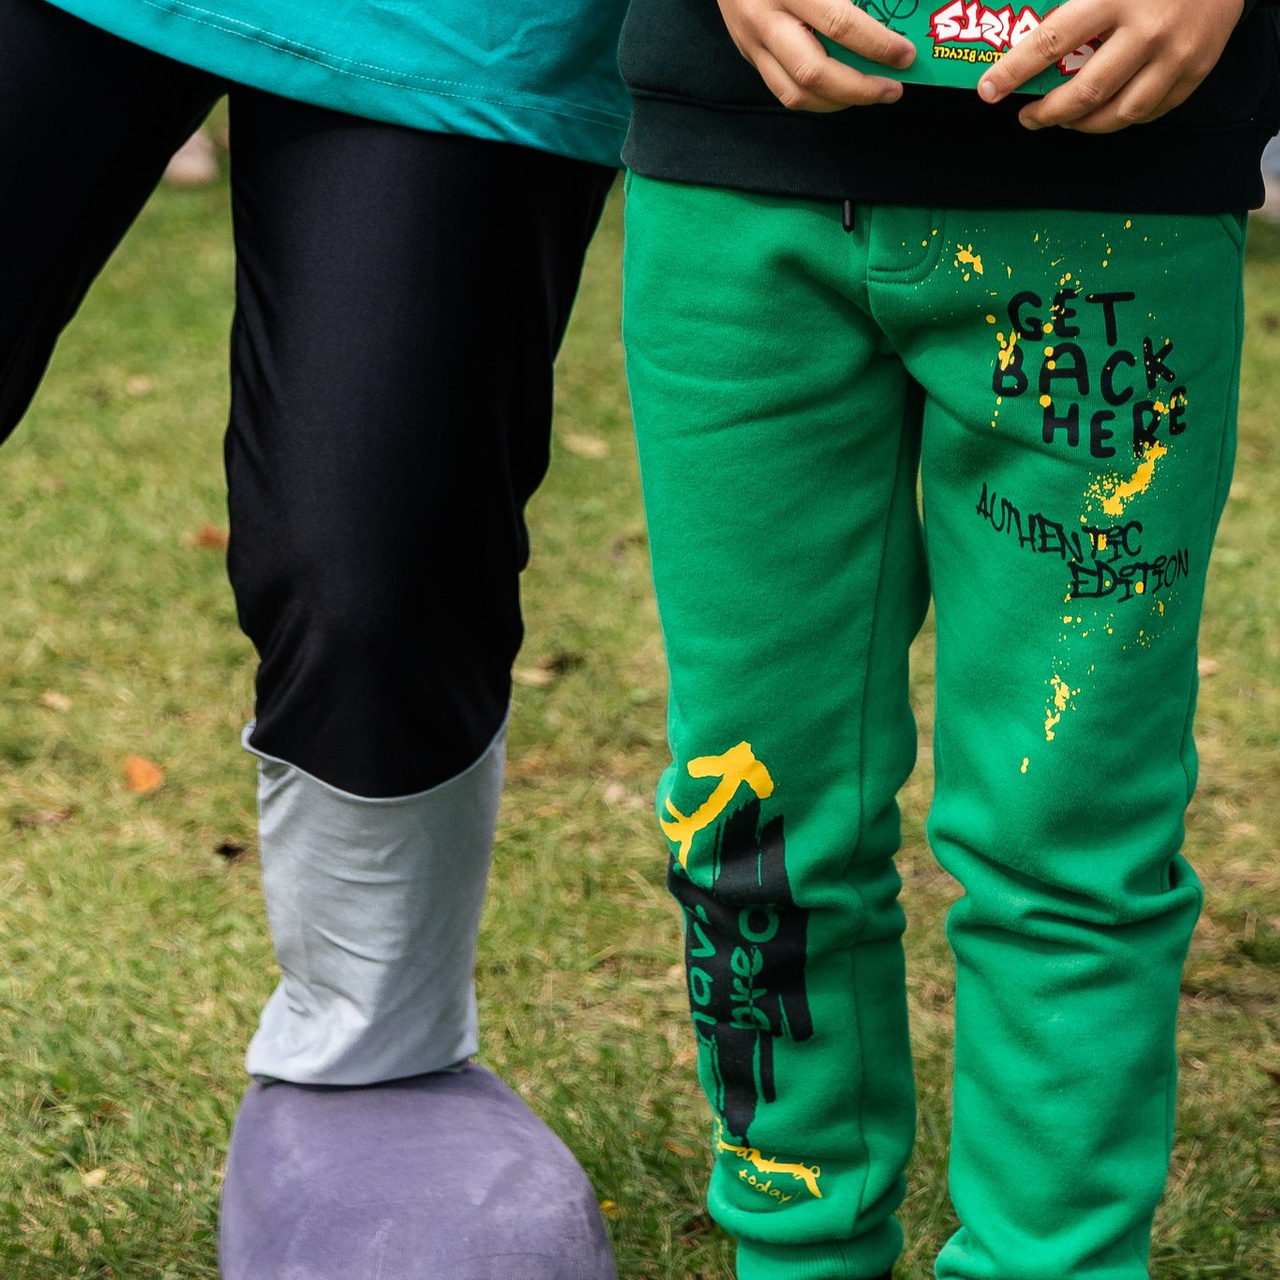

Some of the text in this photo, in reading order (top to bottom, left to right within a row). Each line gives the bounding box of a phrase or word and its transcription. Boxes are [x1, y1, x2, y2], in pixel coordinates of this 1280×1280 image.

[933, 45, 977, 63] BICYCLE
[1007, 288, 1136, 347] GET
[992, 336, 1176, 406] BACK
[1042, 385, 1187, 460] HERE
[975, 482, 1143, 563] AUTHENTIC
[1067, 548, 1189, 603] EDITION
